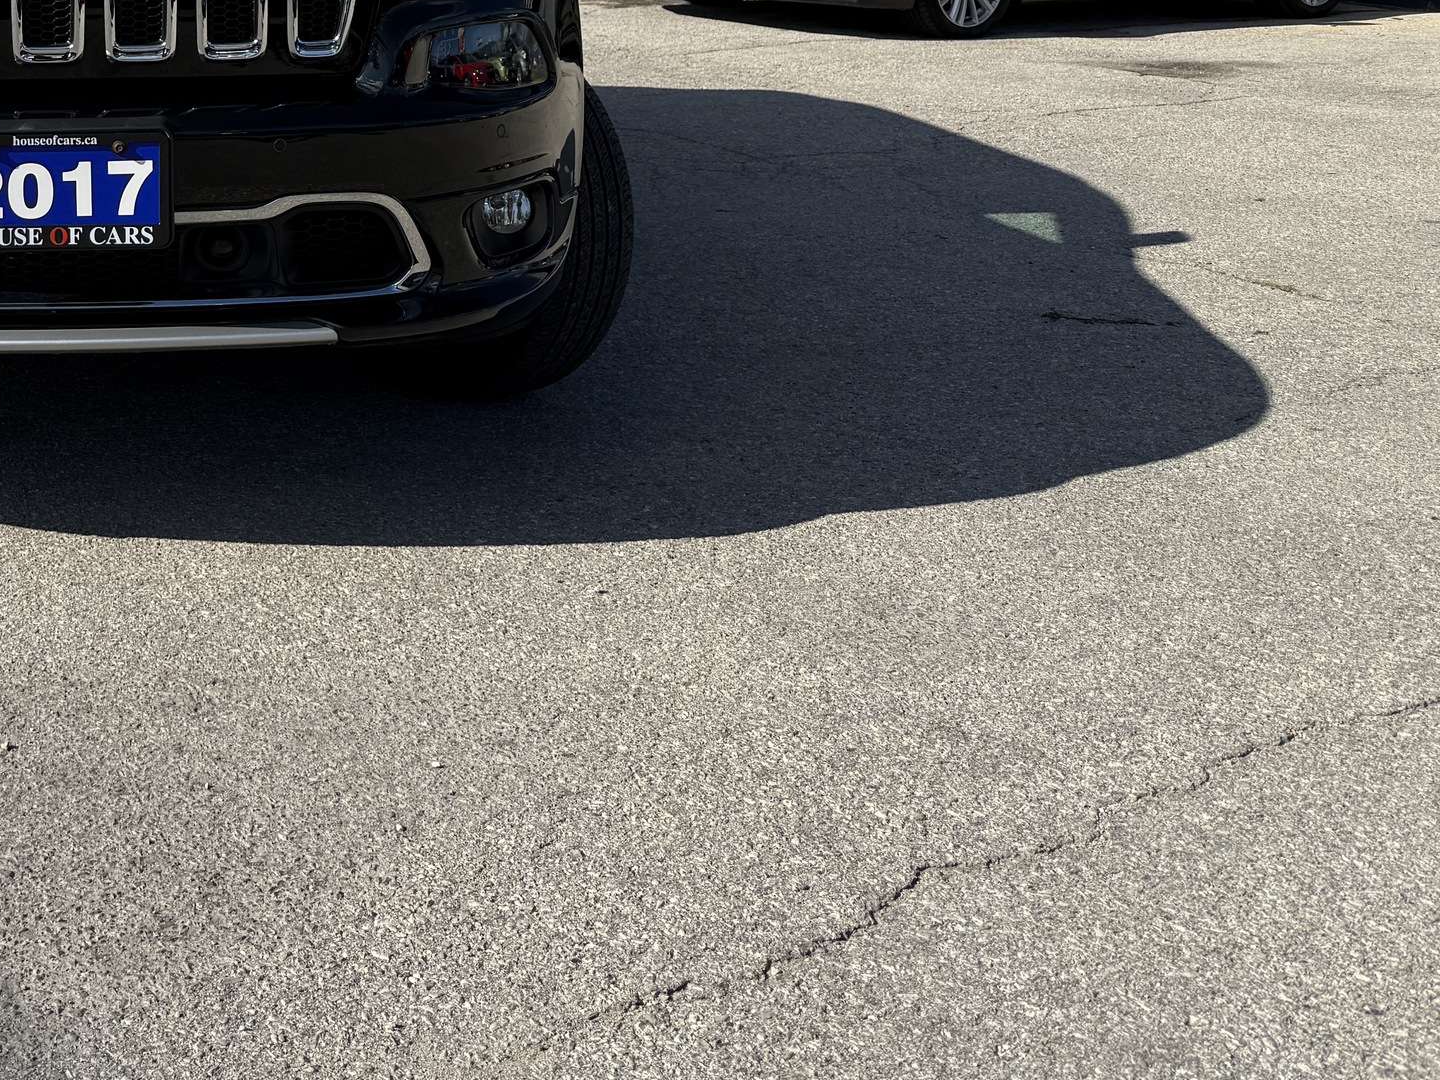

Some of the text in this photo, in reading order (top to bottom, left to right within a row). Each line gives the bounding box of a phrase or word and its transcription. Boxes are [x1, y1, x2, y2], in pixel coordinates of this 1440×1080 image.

[12, 135, 97, 147] houseofcars.ca
[49, 227, 83, 248] OF
[89, 226, 154, 245] CARS
